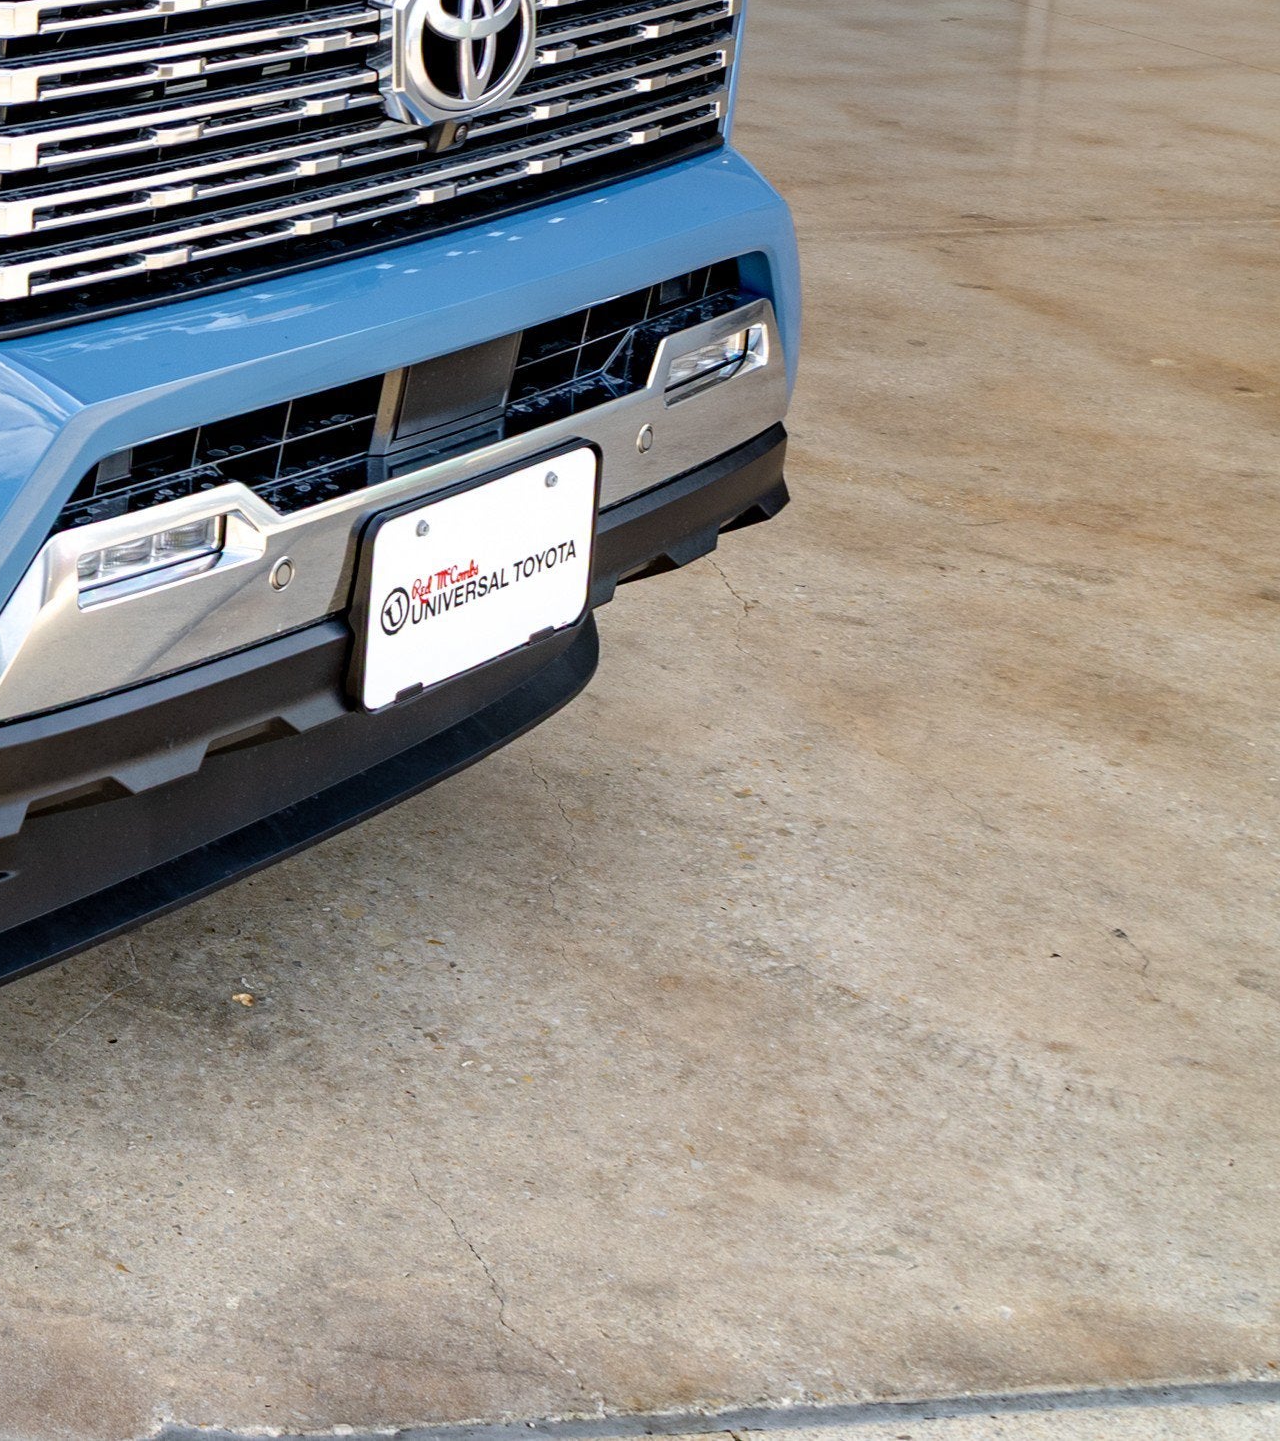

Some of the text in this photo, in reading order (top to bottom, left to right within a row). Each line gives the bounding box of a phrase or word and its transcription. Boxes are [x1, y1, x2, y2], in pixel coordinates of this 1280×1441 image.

[411, 539, 577, 625] UNIVERSAL TOYOTA
[412, 559, 479, 604] Red McCombs
